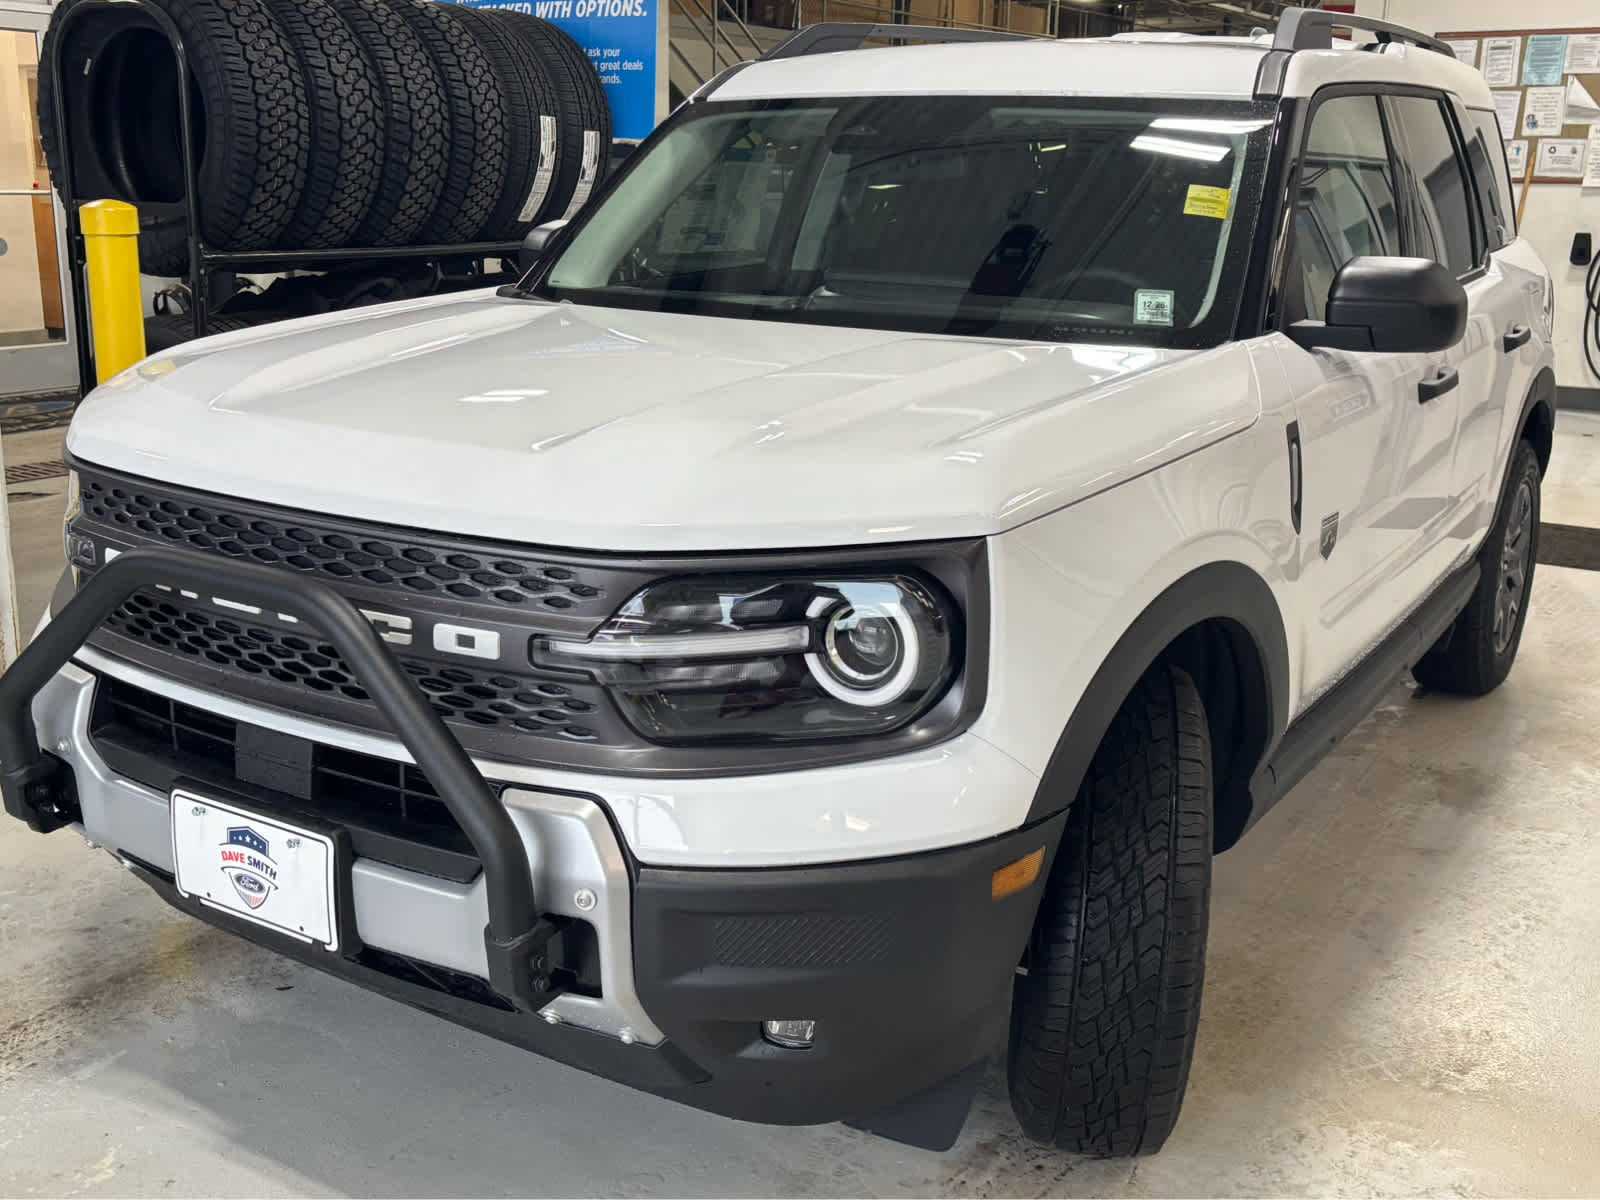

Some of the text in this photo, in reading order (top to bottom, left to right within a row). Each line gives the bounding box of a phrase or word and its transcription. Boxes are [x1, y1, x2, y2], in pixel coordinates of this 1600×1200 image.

[536, 1, 572, 18] WITH
[576, 0, 647, 17] OPTIONS.
[587, 48, 600, 56] ask
[603, 48, 620, 58] your
[600, 61, 620, 72] great
[623, 60, 643, 71] deals
[221, 850, 277, 880] DAVE SMITH
